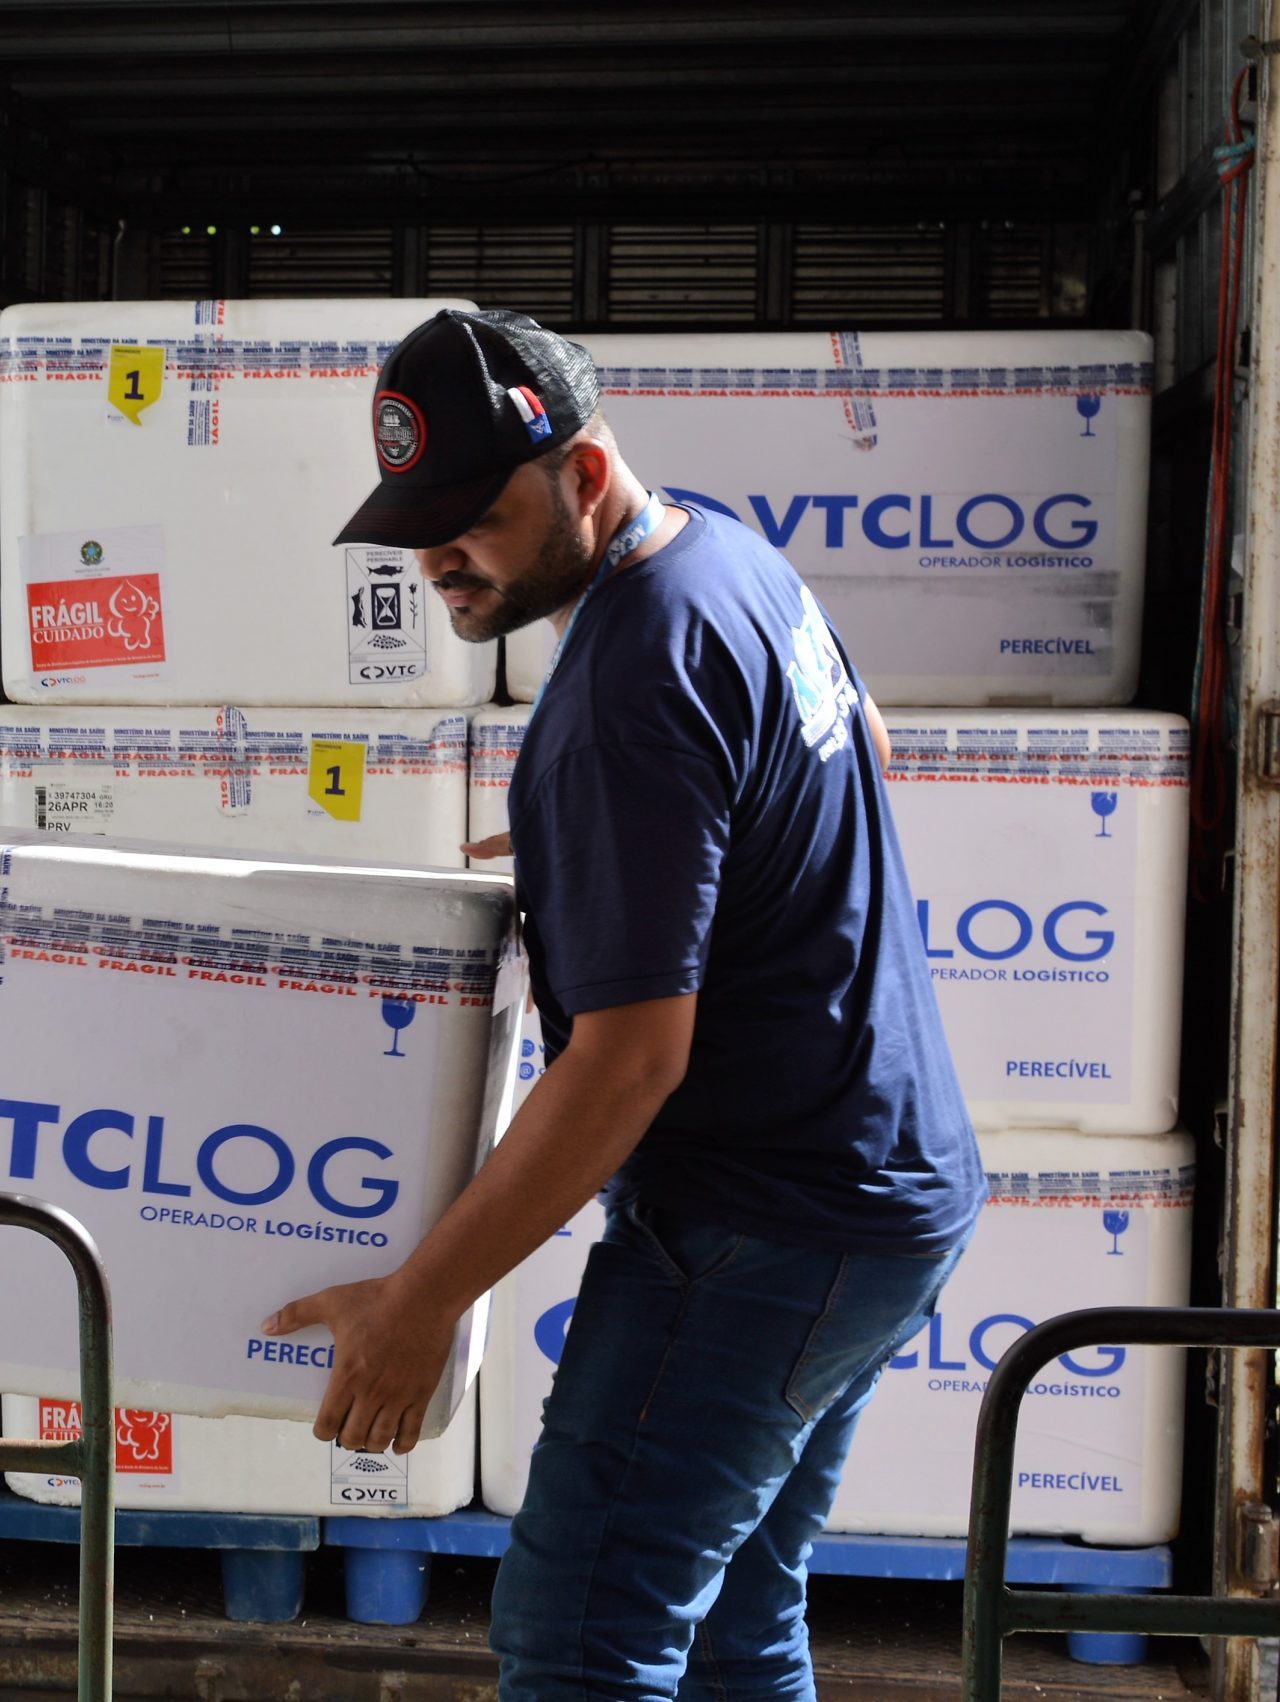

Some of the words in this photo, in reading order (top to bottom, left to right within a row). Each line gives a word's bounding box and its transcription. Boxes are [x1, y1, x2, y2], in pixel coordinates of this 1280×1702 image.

[124, 370, 144, 400] 1
[748, 493, 1098, 550] VTCLOG
[919, 555, 1002, 568] OPERADOR
[1006, 552, 1093, 568] LOGÍSTICO
[31, 598, 103, 629] FRÁGIL
[33, 626, 105, 644] CUIDADO
[1000, 637, 1094, 655] PERECÍVEL
[386, 665, 416, 675] VTC
[325, 765, 345, 796] 1
[54, 792, 96, 800] 39747304
[48, 801, 88, 812] 26APR
[48, 822, 71, 831] PRV
[917, 899, 1115, 961] LOG
[10, 948, 87, 966] FRÁGIL
[98, 959, 177, 977] FRÁGIL
[188, 969, 266, 987] FRÁGIL
[278, 979, 357, 996] FRÁGIL
[368, 988, 448, 1005] FRÁGIL
[931, 968, 1007, 980] PERADOR
[1013, 966, 1109, 982] LOGÍSTICO
[1006, 1059, 1111, 1078] PERECÍVEL
[140, 1206, 257, 1233] OPERADOR
[265, 1220, 388, 1248] LOGÍSTICO
[247, 1338, 335, 1369] PERECÍ
[1025, 1381, 1121, 1398] LOGÍSTICO
[41, 1402, 82, 1430] FRÁ
[1018, 1472, 1123, 1492] PERECÍVEL
[368, 1489, 398, 1500] VTC
